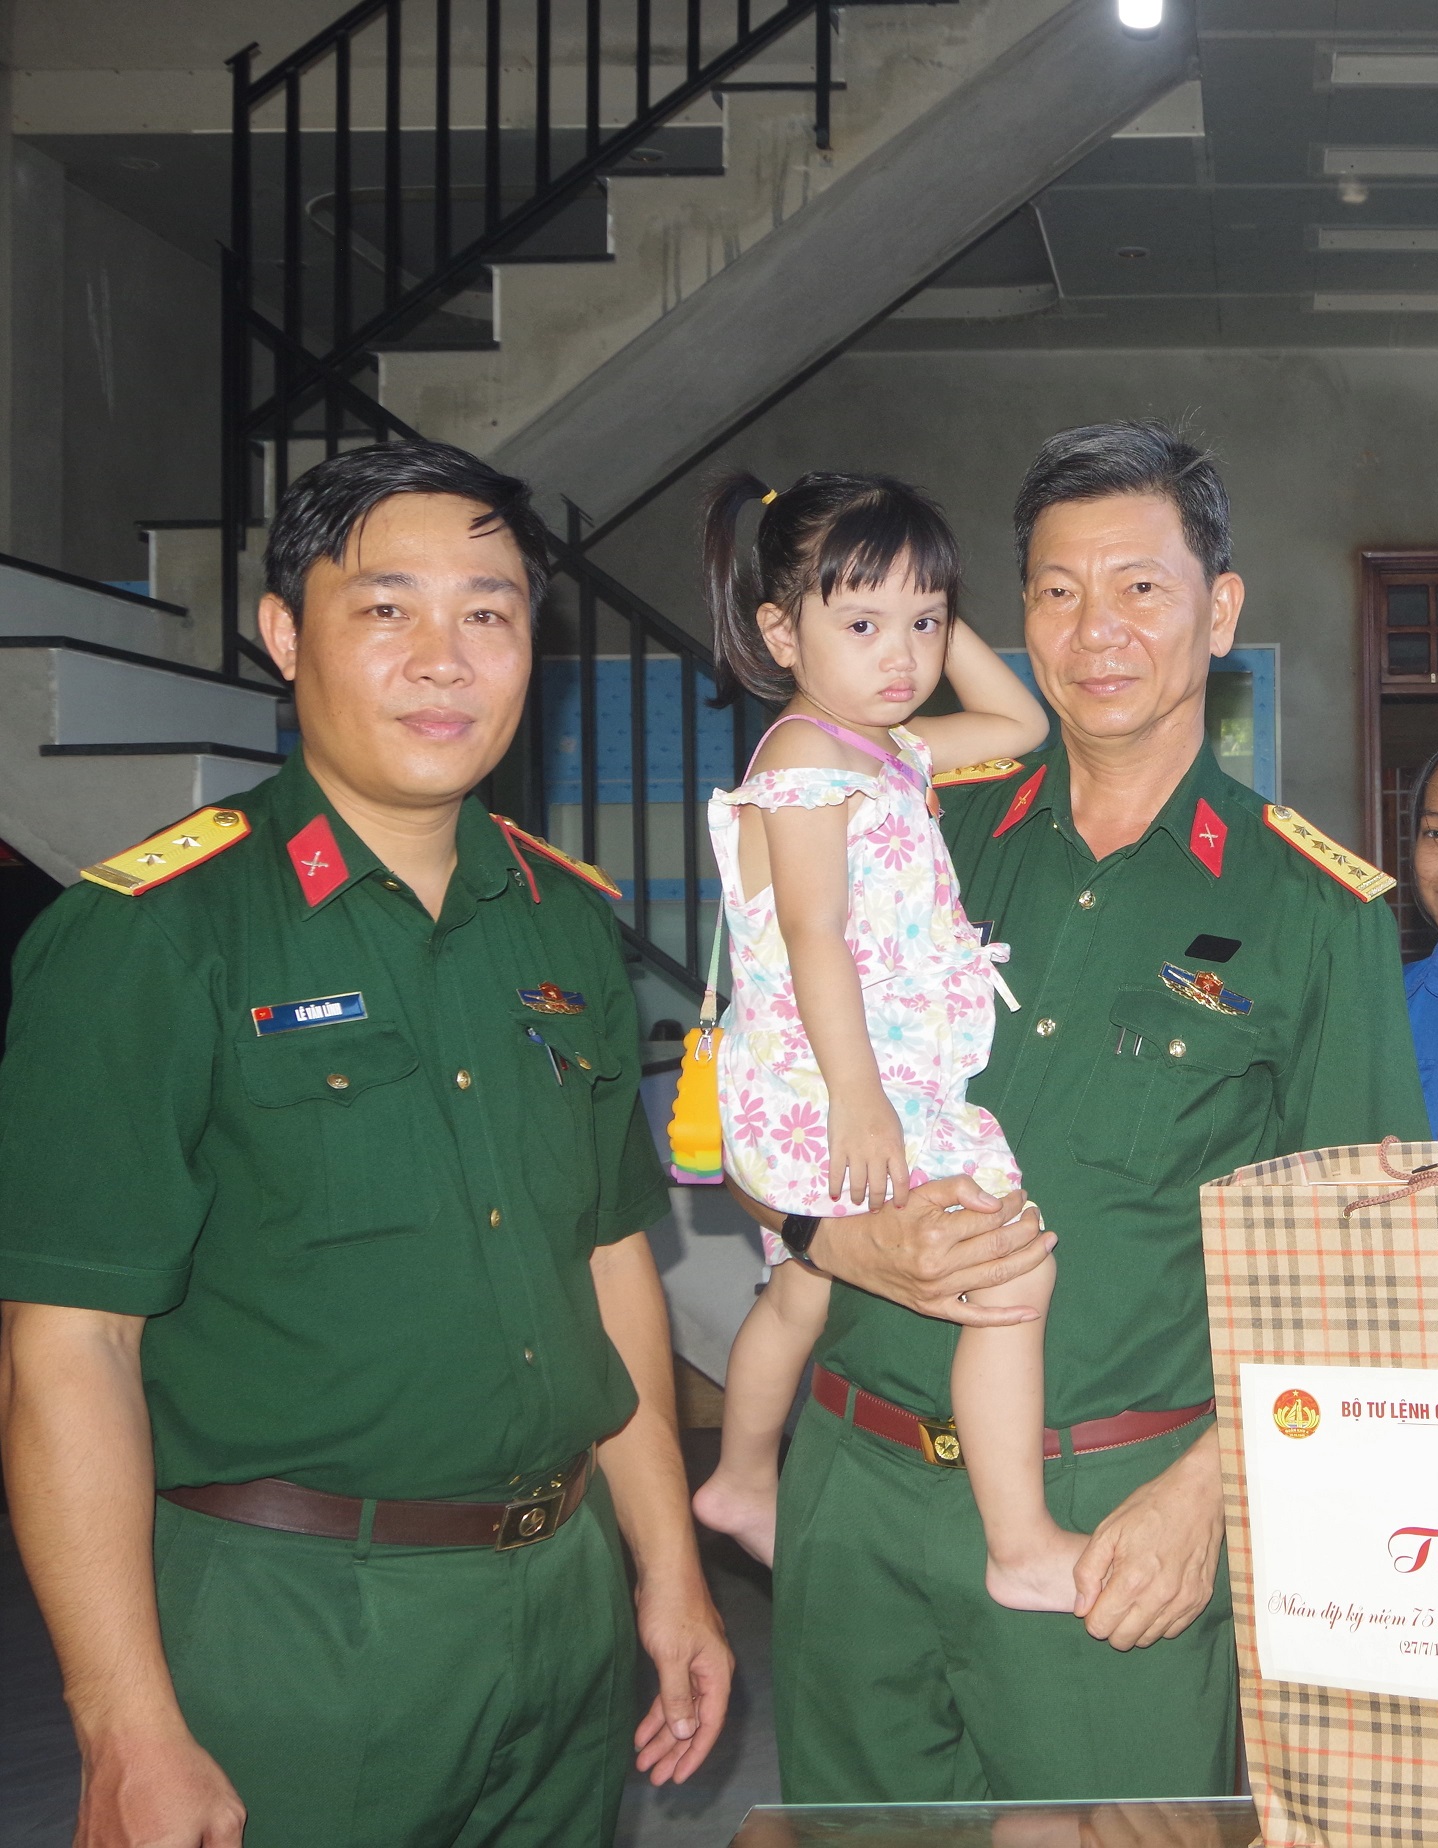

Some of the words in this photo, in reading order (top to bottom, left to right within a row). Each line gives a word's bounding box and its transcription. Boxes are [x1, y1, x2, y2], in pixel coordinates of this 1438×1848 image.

[295, 1005, 308, 1022] LÊ
[1341, 1397, 1362, 1422] BỘ
[1366, 1400, 1387, 1419] TƯ
[1390, 1398, 1430, 1423] LỆNH
[1320, 1601, 1343, 1630] dịp
[1411, 1607, 1435, 1628] 75
